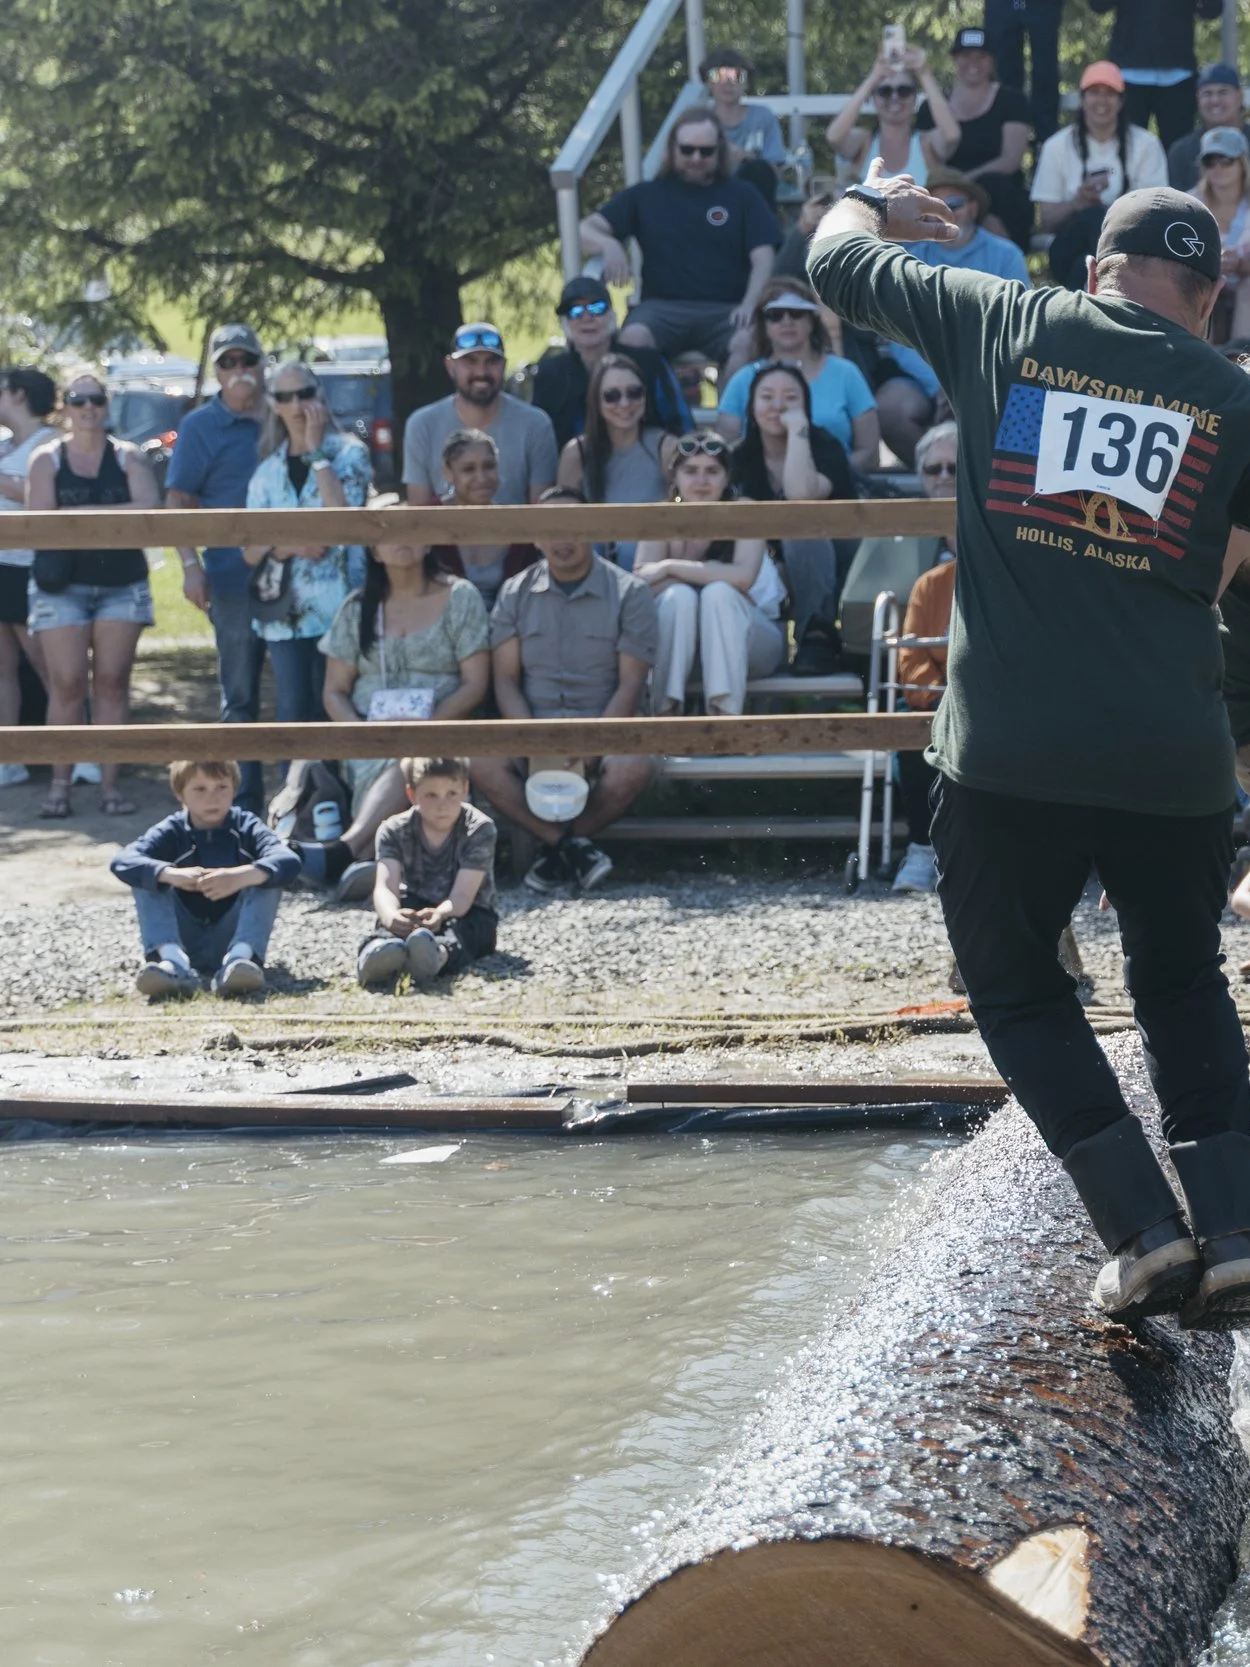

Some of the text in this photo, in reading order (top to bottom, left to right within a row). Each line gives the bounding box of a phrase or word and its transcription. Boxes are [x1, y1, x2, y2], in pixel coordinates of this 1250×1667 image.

[1020, 357, 1145, 405] DAWSON
[1063, 406, 1180, 494] 136
[1016, 526, 1152, 571] HOLLIS, ALASKA
